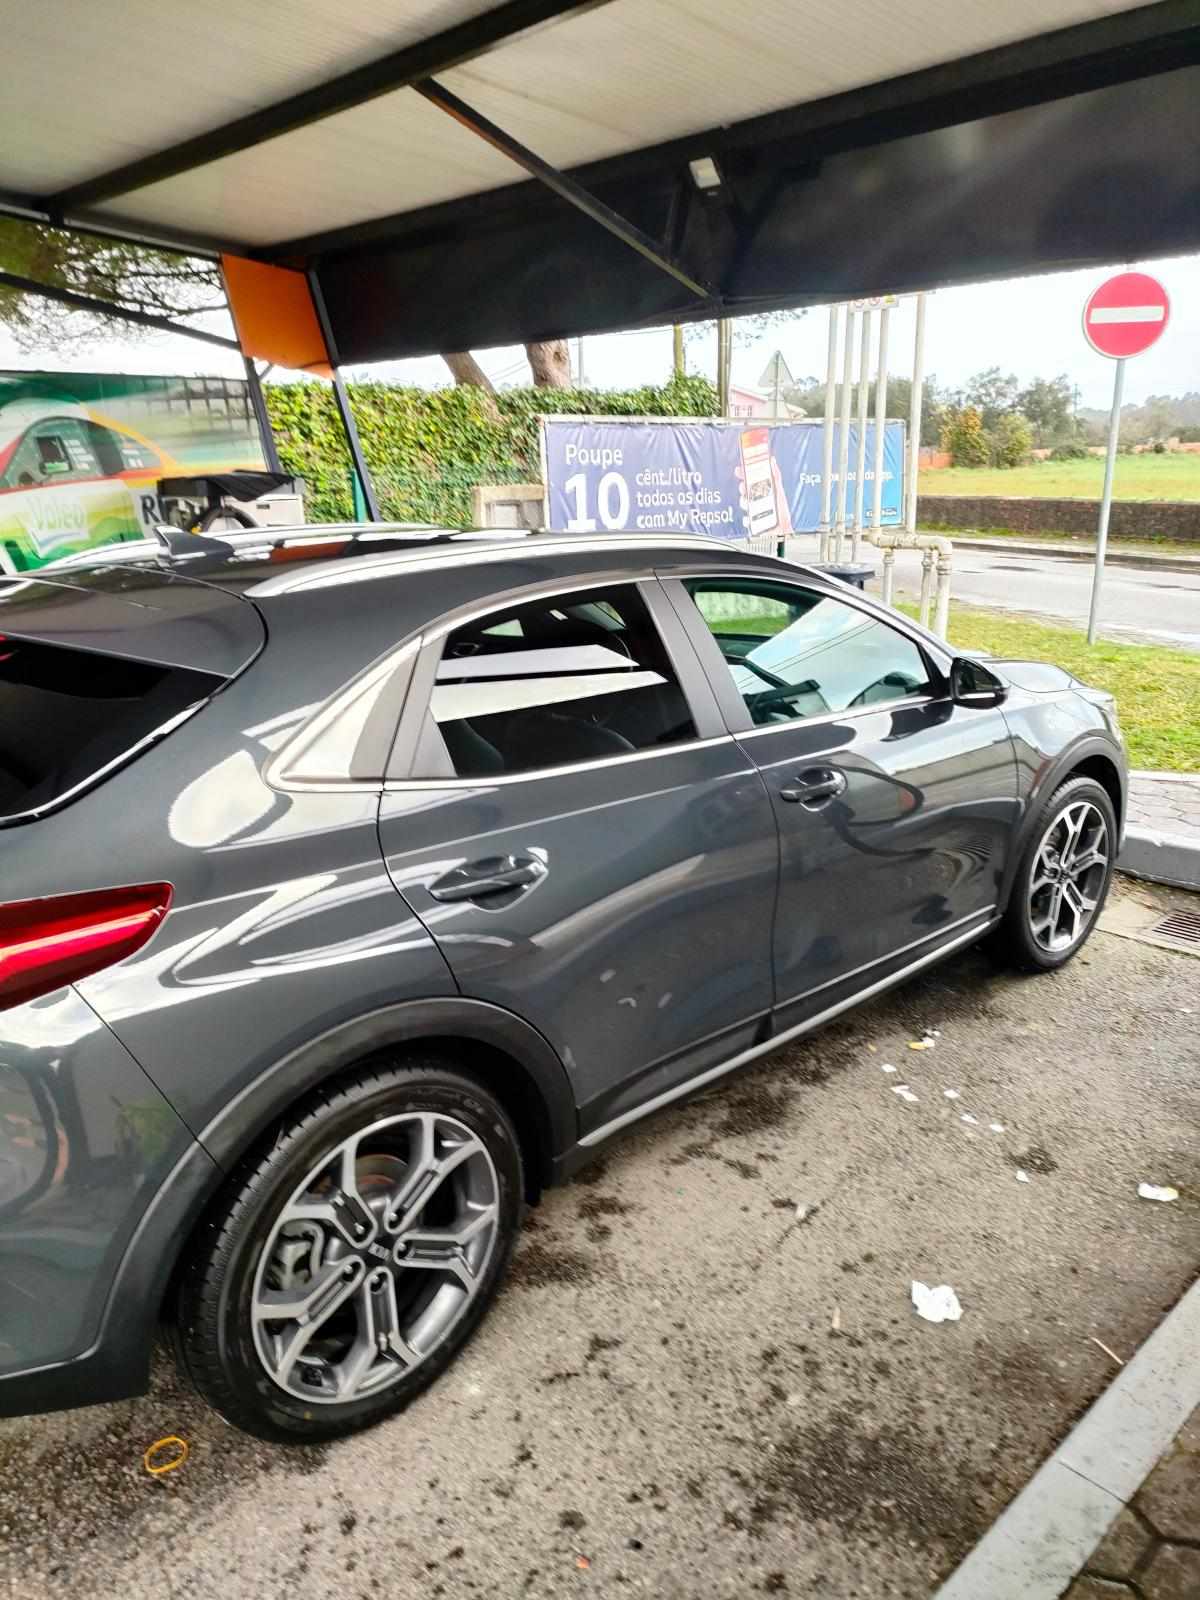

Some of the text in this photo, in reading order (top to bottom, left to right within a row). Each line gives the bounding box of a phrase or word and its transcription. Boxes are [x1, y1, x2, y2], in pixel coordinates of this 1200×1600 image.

[565, 444, 623, 470] Poupe
[565, 471, 630, 531] 10
[637, 488, 721, 508] todos os dias
[636, 513, 666, 529] com
[667, 509, 688, 530] My
[689, 505, 734, 529] Repsol
